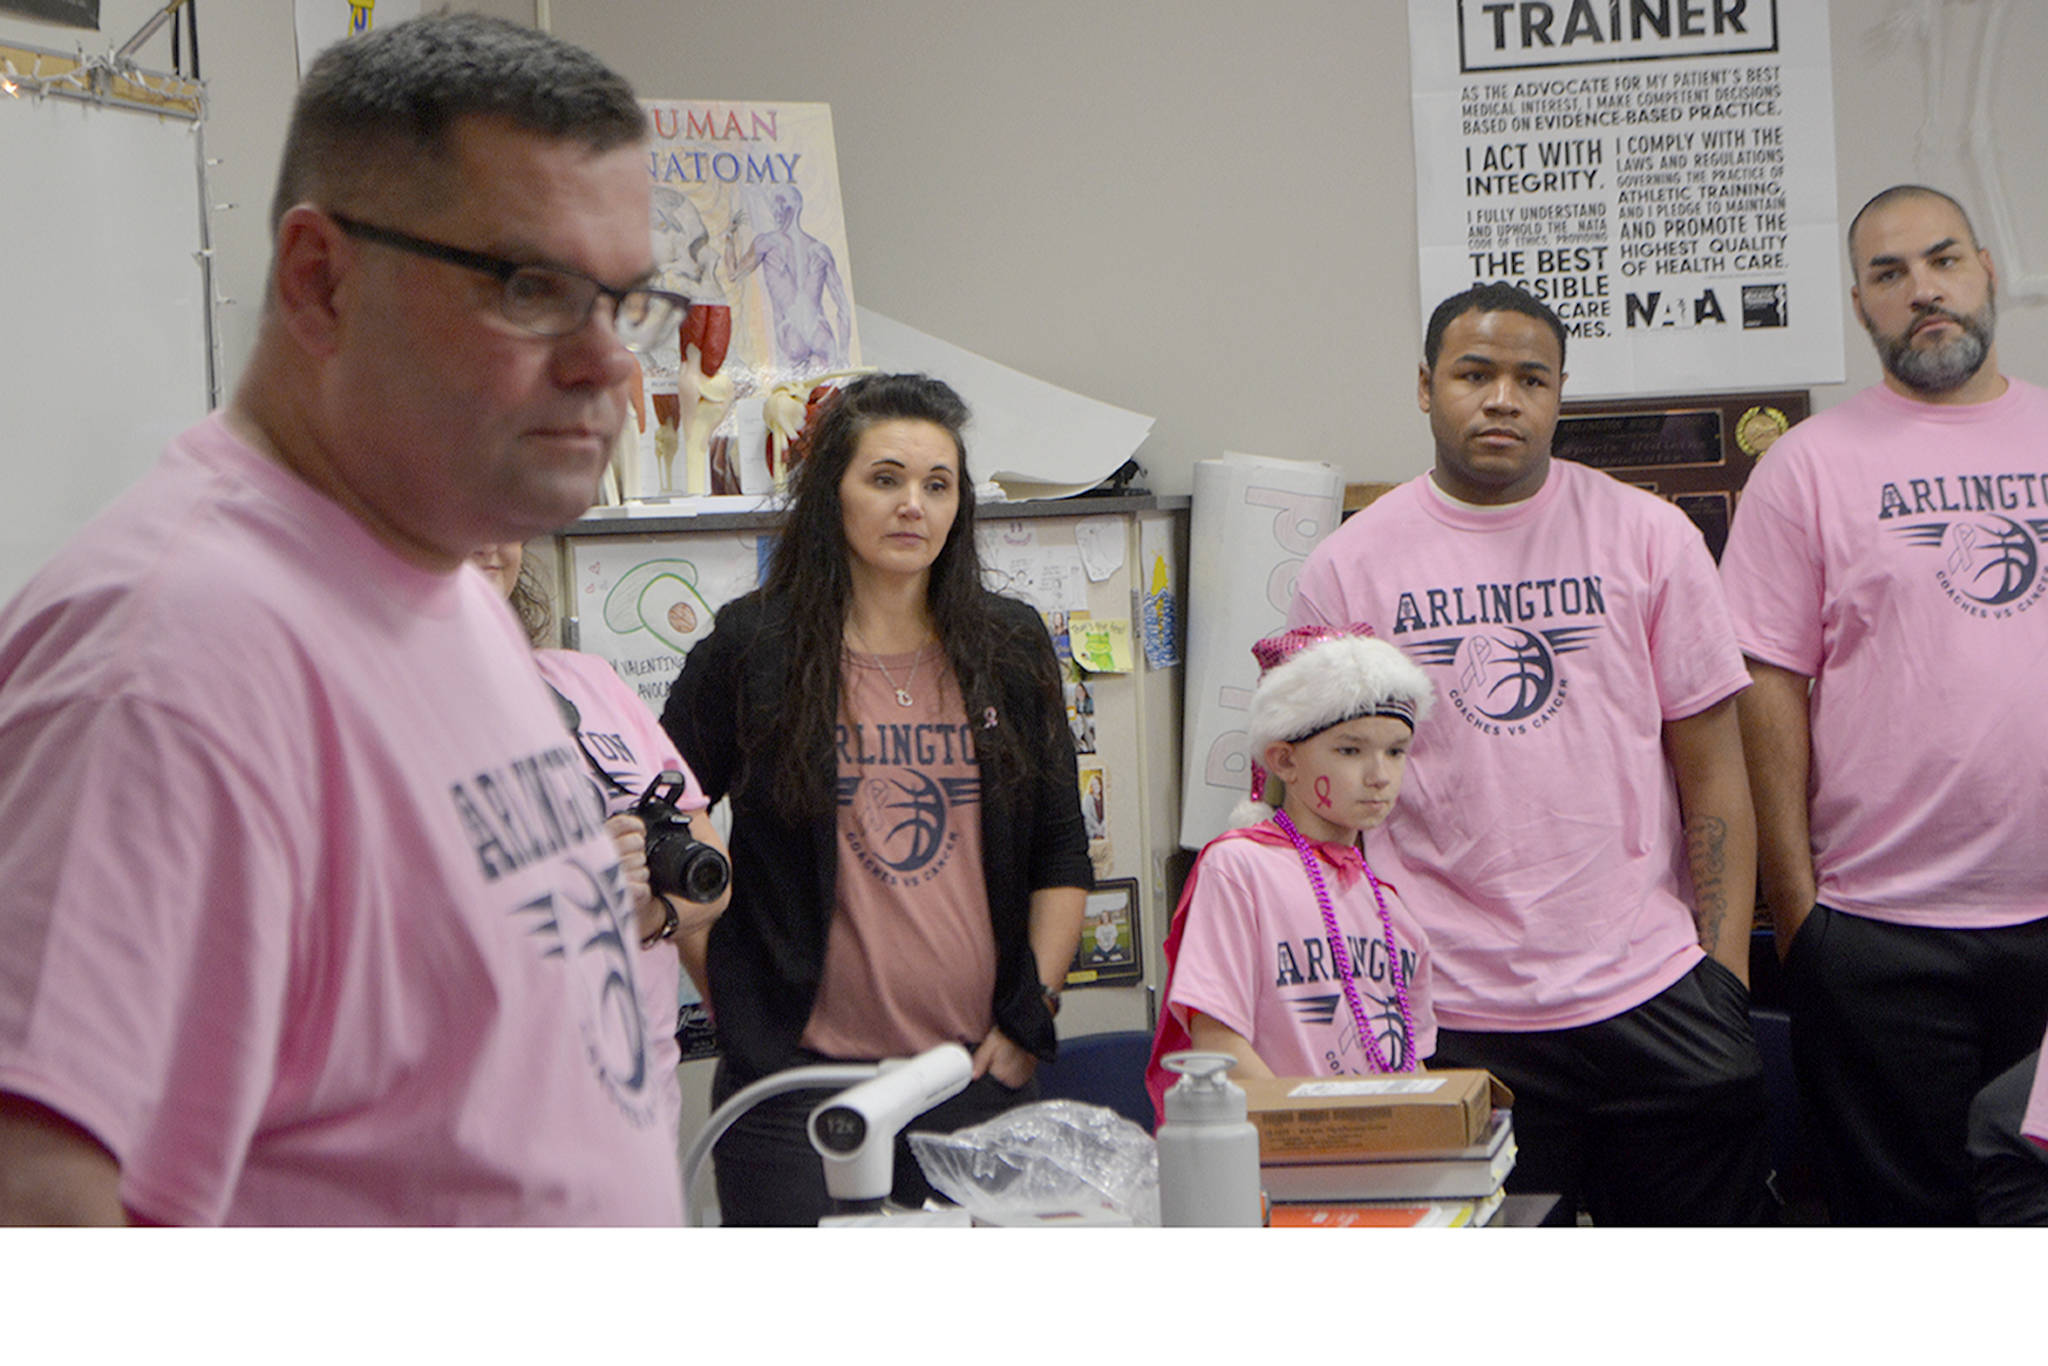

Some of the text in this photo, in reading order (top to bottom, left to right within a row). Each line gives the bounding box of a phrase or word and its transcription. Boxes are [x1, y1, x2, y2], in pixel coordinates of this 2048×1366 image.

[1482, 0, 1748, 51] TRAINER
[1461, 65, 1781, 101] AS THE ADVOCATE FOR MY PATIENT'S BEST
[1462, 101, 1516, 118] MEDICAL
[1597, 93, 1631, 109] MAKE
[1637, 88, 1710, 107] COMPETENT
[1715, 83, 1783, 101] DECISIONS
[652, 107, 778, 142] UMAN
[1462, 117, 1508, 136] BASED
[1511, 115, 1531, 132] ON
[1535, 107, 1683, 131] EVIDENCE-BASED
[1465, 138, 1603, 173] I ACT WITH
[1615, 127, 1785, 155] I COMPLY WITH THE
[648, 150, 802, 185] ATOMY
[1616, 148, 1785, 173] LAWS AND REGULATIONS
[1466, 168, 1605, 197] INTEGRITY.
[1616, 165, 1785, 188] GOVERNING THE PRACTICE OF
[1617, 186, 1692, 205] ATHLETIC
[1619, 204, 1645, 220] AND
[1656, 201, 1701, 218] PLEDGE
[1706, 200, 1722, 215] TO
[1726, 195, 1787, 213] MAINTAIN
[1476, 207, 1516, 225] FULLY
[1520, 201, 1608, 222] UNDERSTAND
[1619, 212, 1787, 241] AND PROMOTE THE
[1468, 224, 1493, 239] AND
[1496, 221, 1543, 238] UPHOLD
[1547, 219, 1568, 235] THE
[1468, 245, 1609, 278] THE BEST
[1620, 234, 1789, 260] HIGHEST QUALITY
[1621, 260, 1648, 278] OF
[1655, 256, 1726, 275] HEALTH
[1472, 274, 1610, 300] SIBLE
[1557, 299, 1612, 320] CARE
[1878, 472, 2048, 521] ARLINGT
[1393, 575, 1606, 635] ARLINGTON
[1935, 569, 1988, 620] COACHES
[1449, 678, 1569, 737] COACHES VS CANCER
[836, 722, 982, 766] RLINGTO
